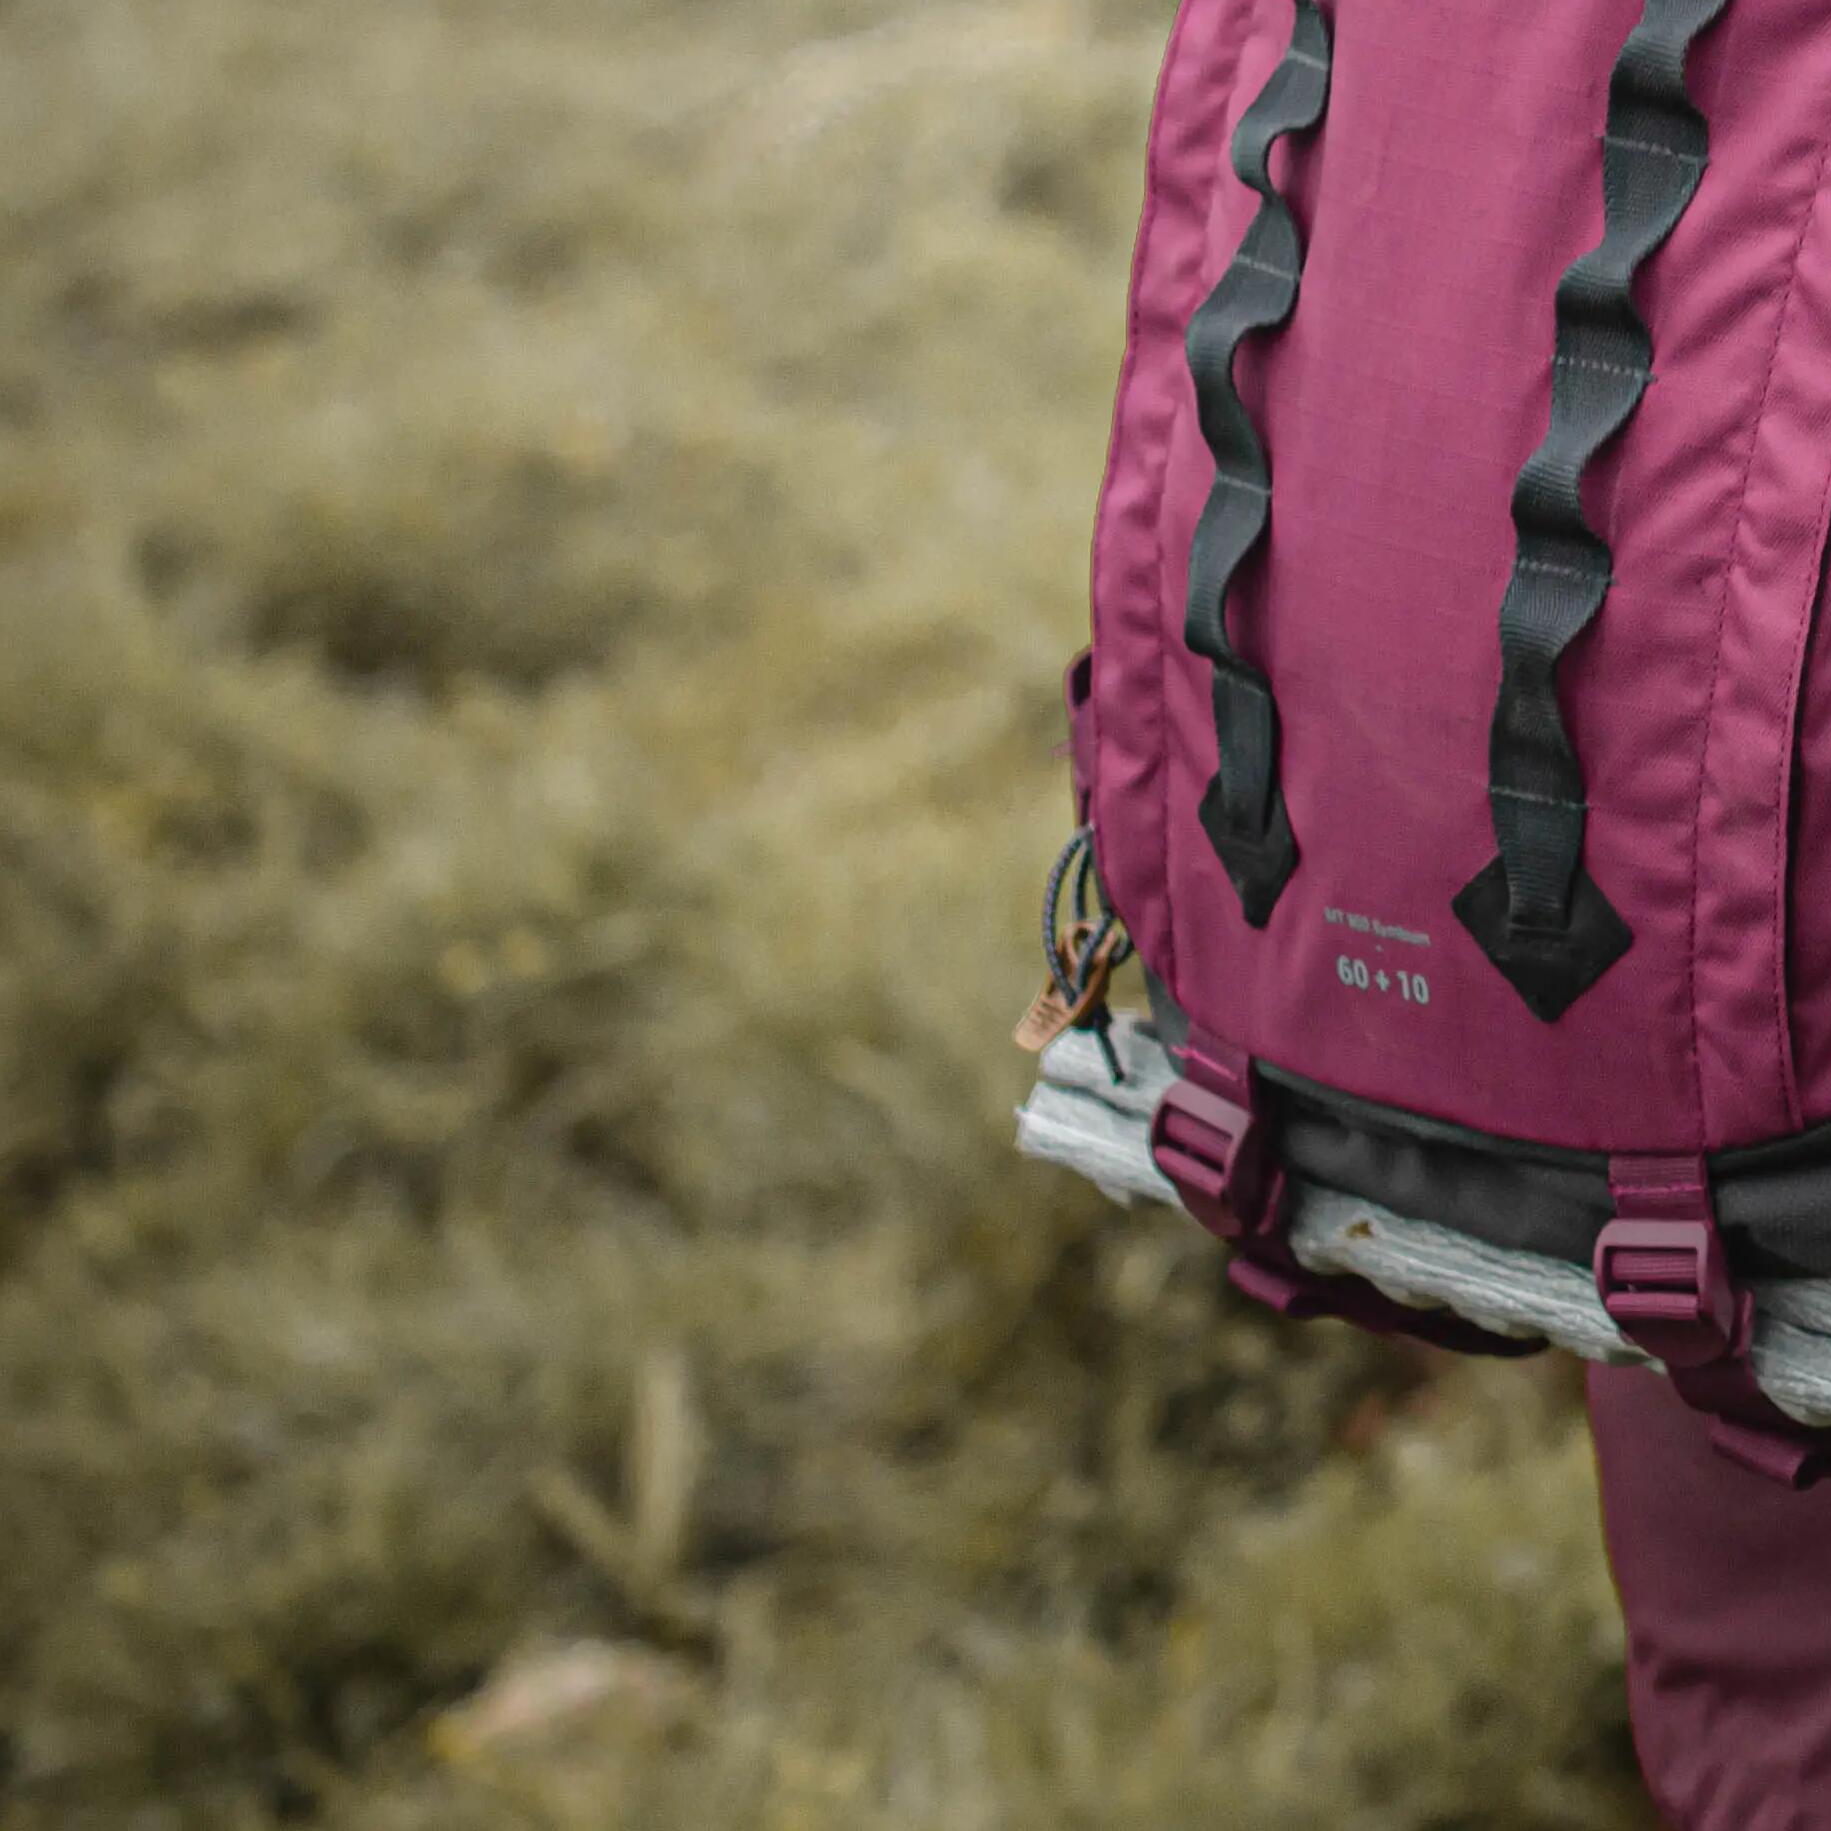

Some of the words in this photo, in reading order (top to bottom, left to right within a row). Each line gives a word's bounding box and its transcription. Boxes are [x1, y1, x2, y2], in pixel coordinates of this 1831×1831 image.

[1336, 955, 1368, 990] 60
[1375, 969, 1390, 992] +
[1396, 970, 1429, 1004] 10
